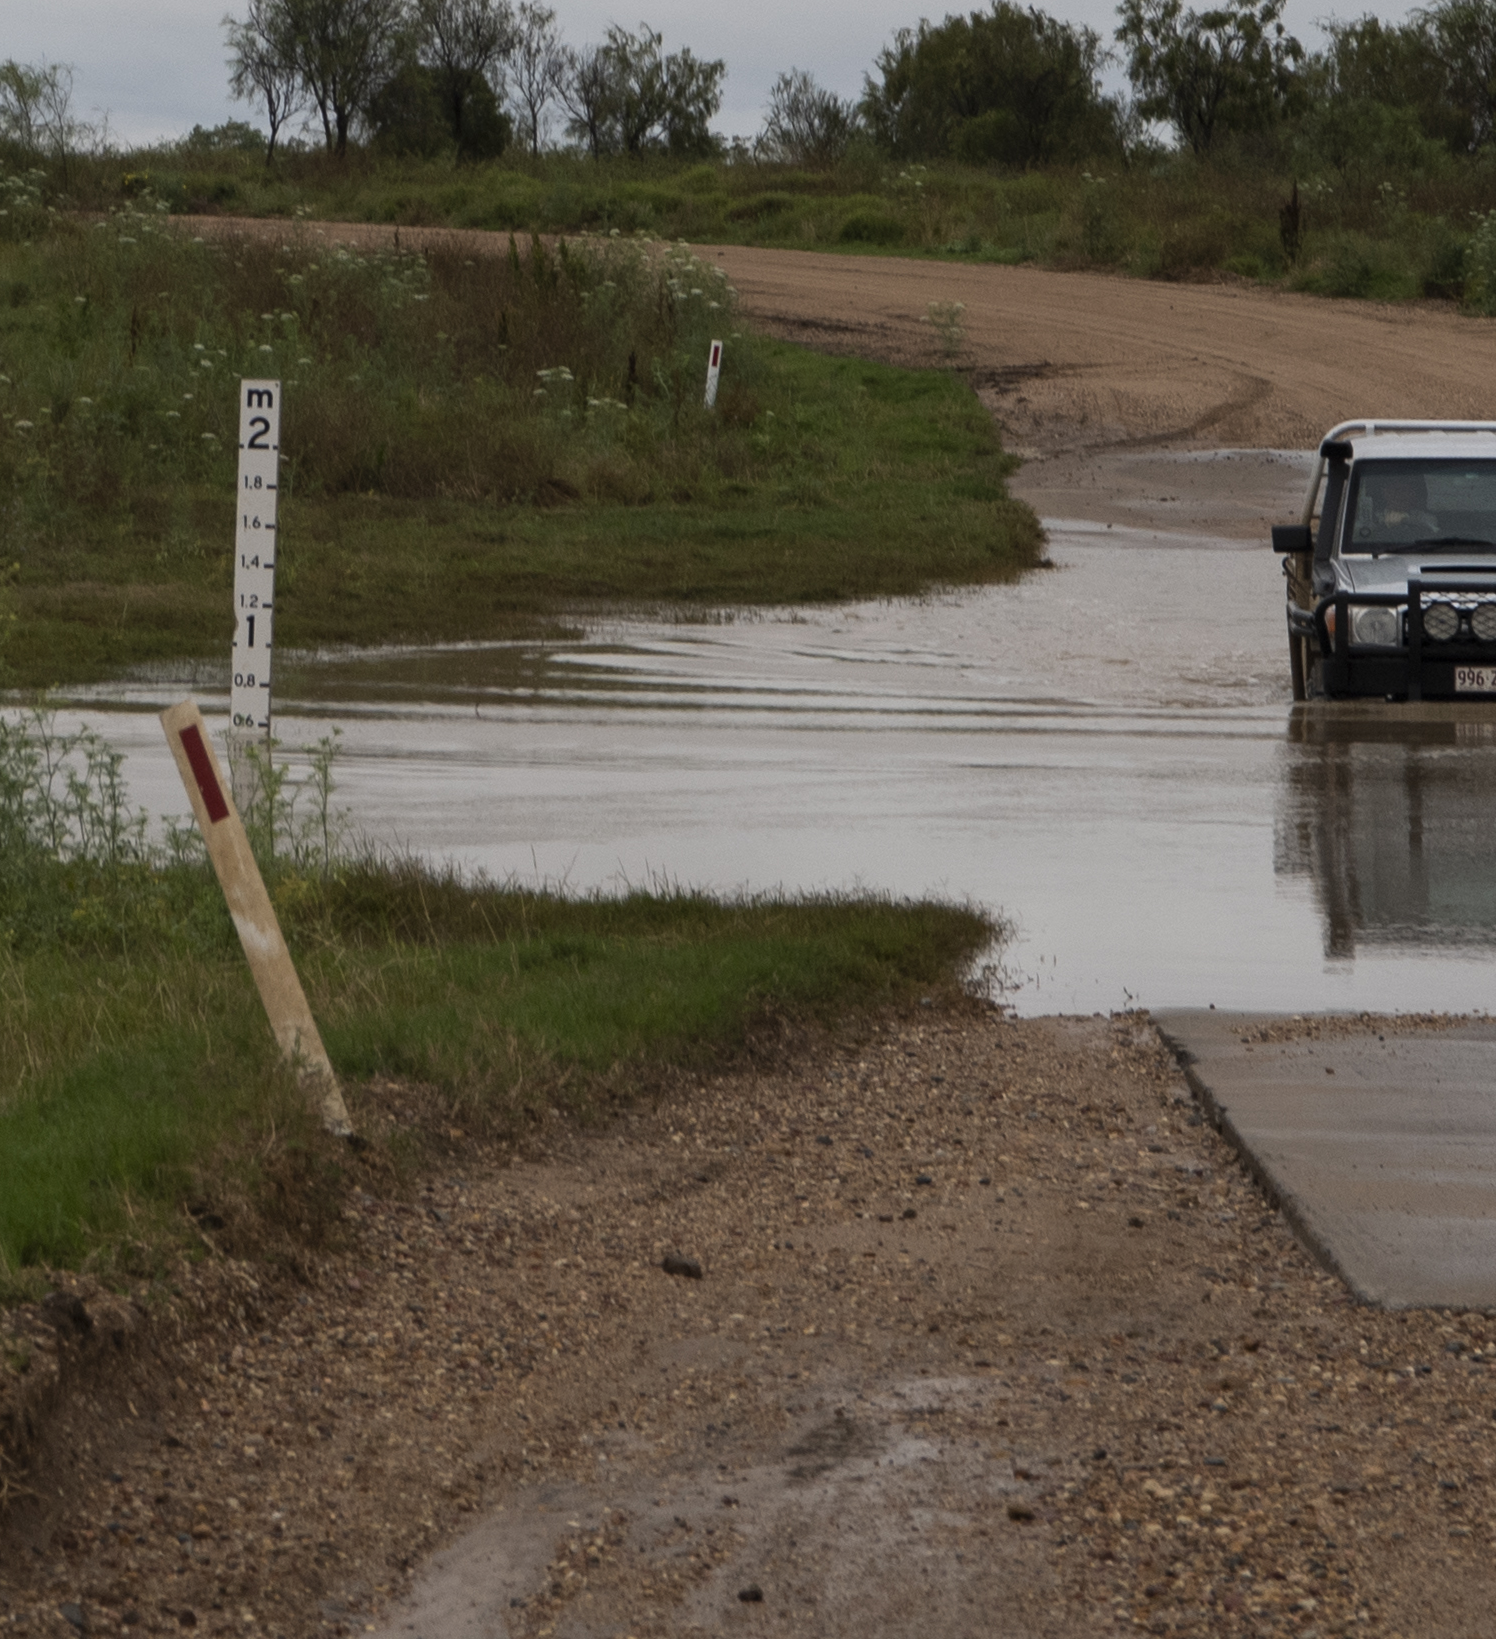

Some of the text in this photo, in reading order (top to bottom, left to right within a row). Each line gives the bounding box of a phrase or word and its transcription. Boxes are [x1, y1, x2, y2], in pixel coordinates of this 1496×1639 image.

[247, 388, 273, 408] m
[248, 416, 270, 449] 2
[244, 475, 262, 490] 1.8
[243, 515, 261, 529] 1.6
[241, 554, 259, 569] 1.4
[240, 594, 258, 608] 1.2
[246, 614, 255, 648] 1
[234, 673, 255, 687] 0.8
[233, 713, 254, 727] 0.6
